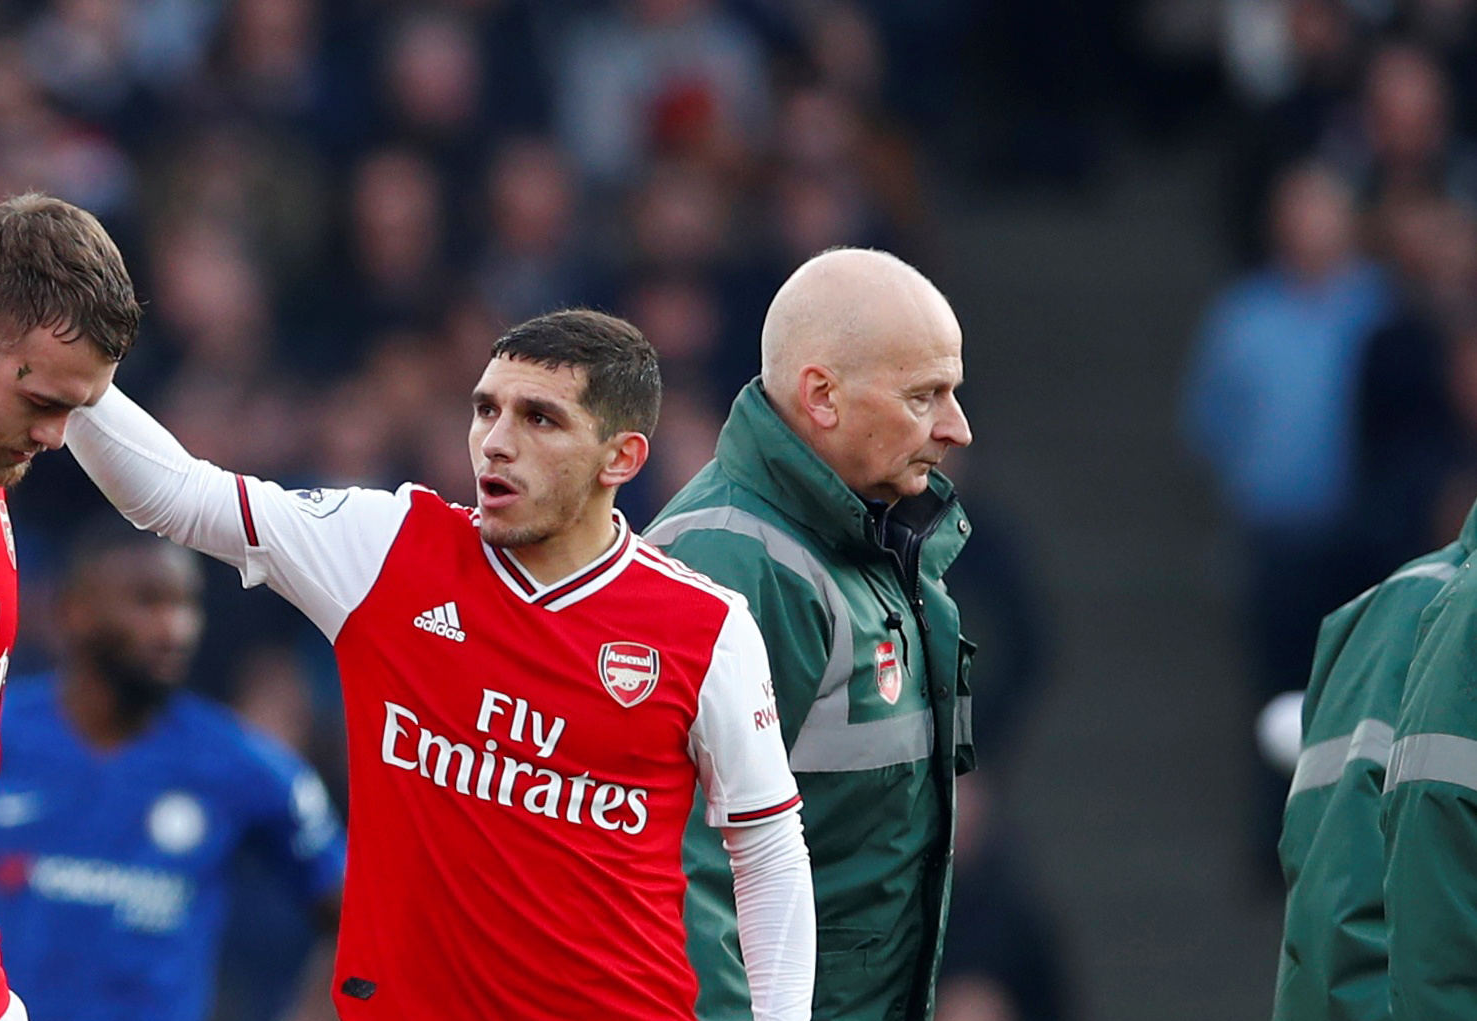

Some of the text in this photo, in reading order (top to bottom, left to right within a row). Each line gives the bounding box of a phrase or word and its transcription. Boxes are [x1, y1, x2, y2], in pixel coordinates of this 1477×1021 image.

[413, 616, 466, 642] adidas
[607, 651, 651, 667] Arsenal
[476, 688, 566, 758] Fly
[382, 701, 648, 835] Emirates
